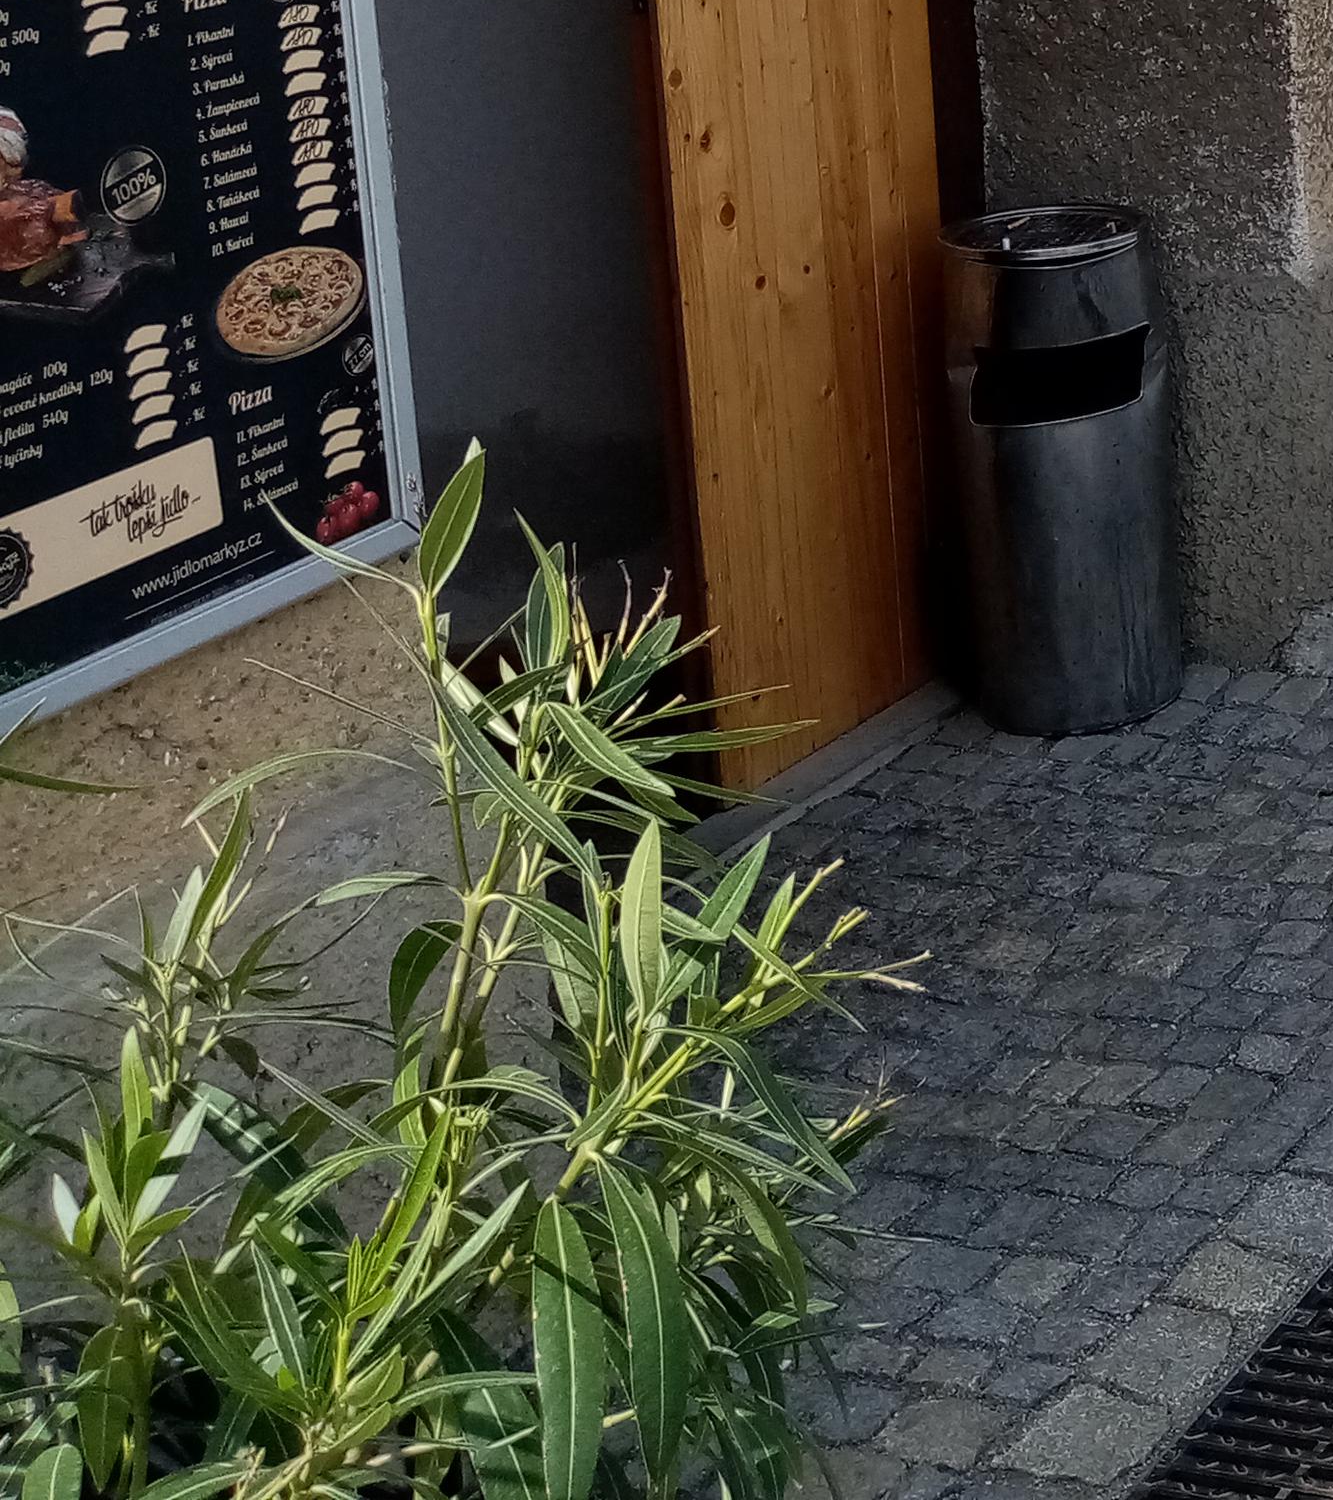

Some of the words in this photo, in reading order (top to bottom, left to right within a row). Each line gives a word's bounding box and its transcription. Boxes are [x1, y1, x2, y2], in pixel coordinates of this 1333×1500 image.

[11, 28, 40, 46] 500g
[195, 25, 234, 45] Pikantní
[201, 49, 234, 70] Sýrová
[111, 168, 157, 205] 100%
[42, 360, 68, 380] 100g
[90, 368, 114, 387] 120g
[228, 385, 273, 416] Pizza
[42, 409, 69, 429] 540g
[79, 501, 113, 538] tak
[132, 532, 263, 600] www.jidlomarkyz.cz
